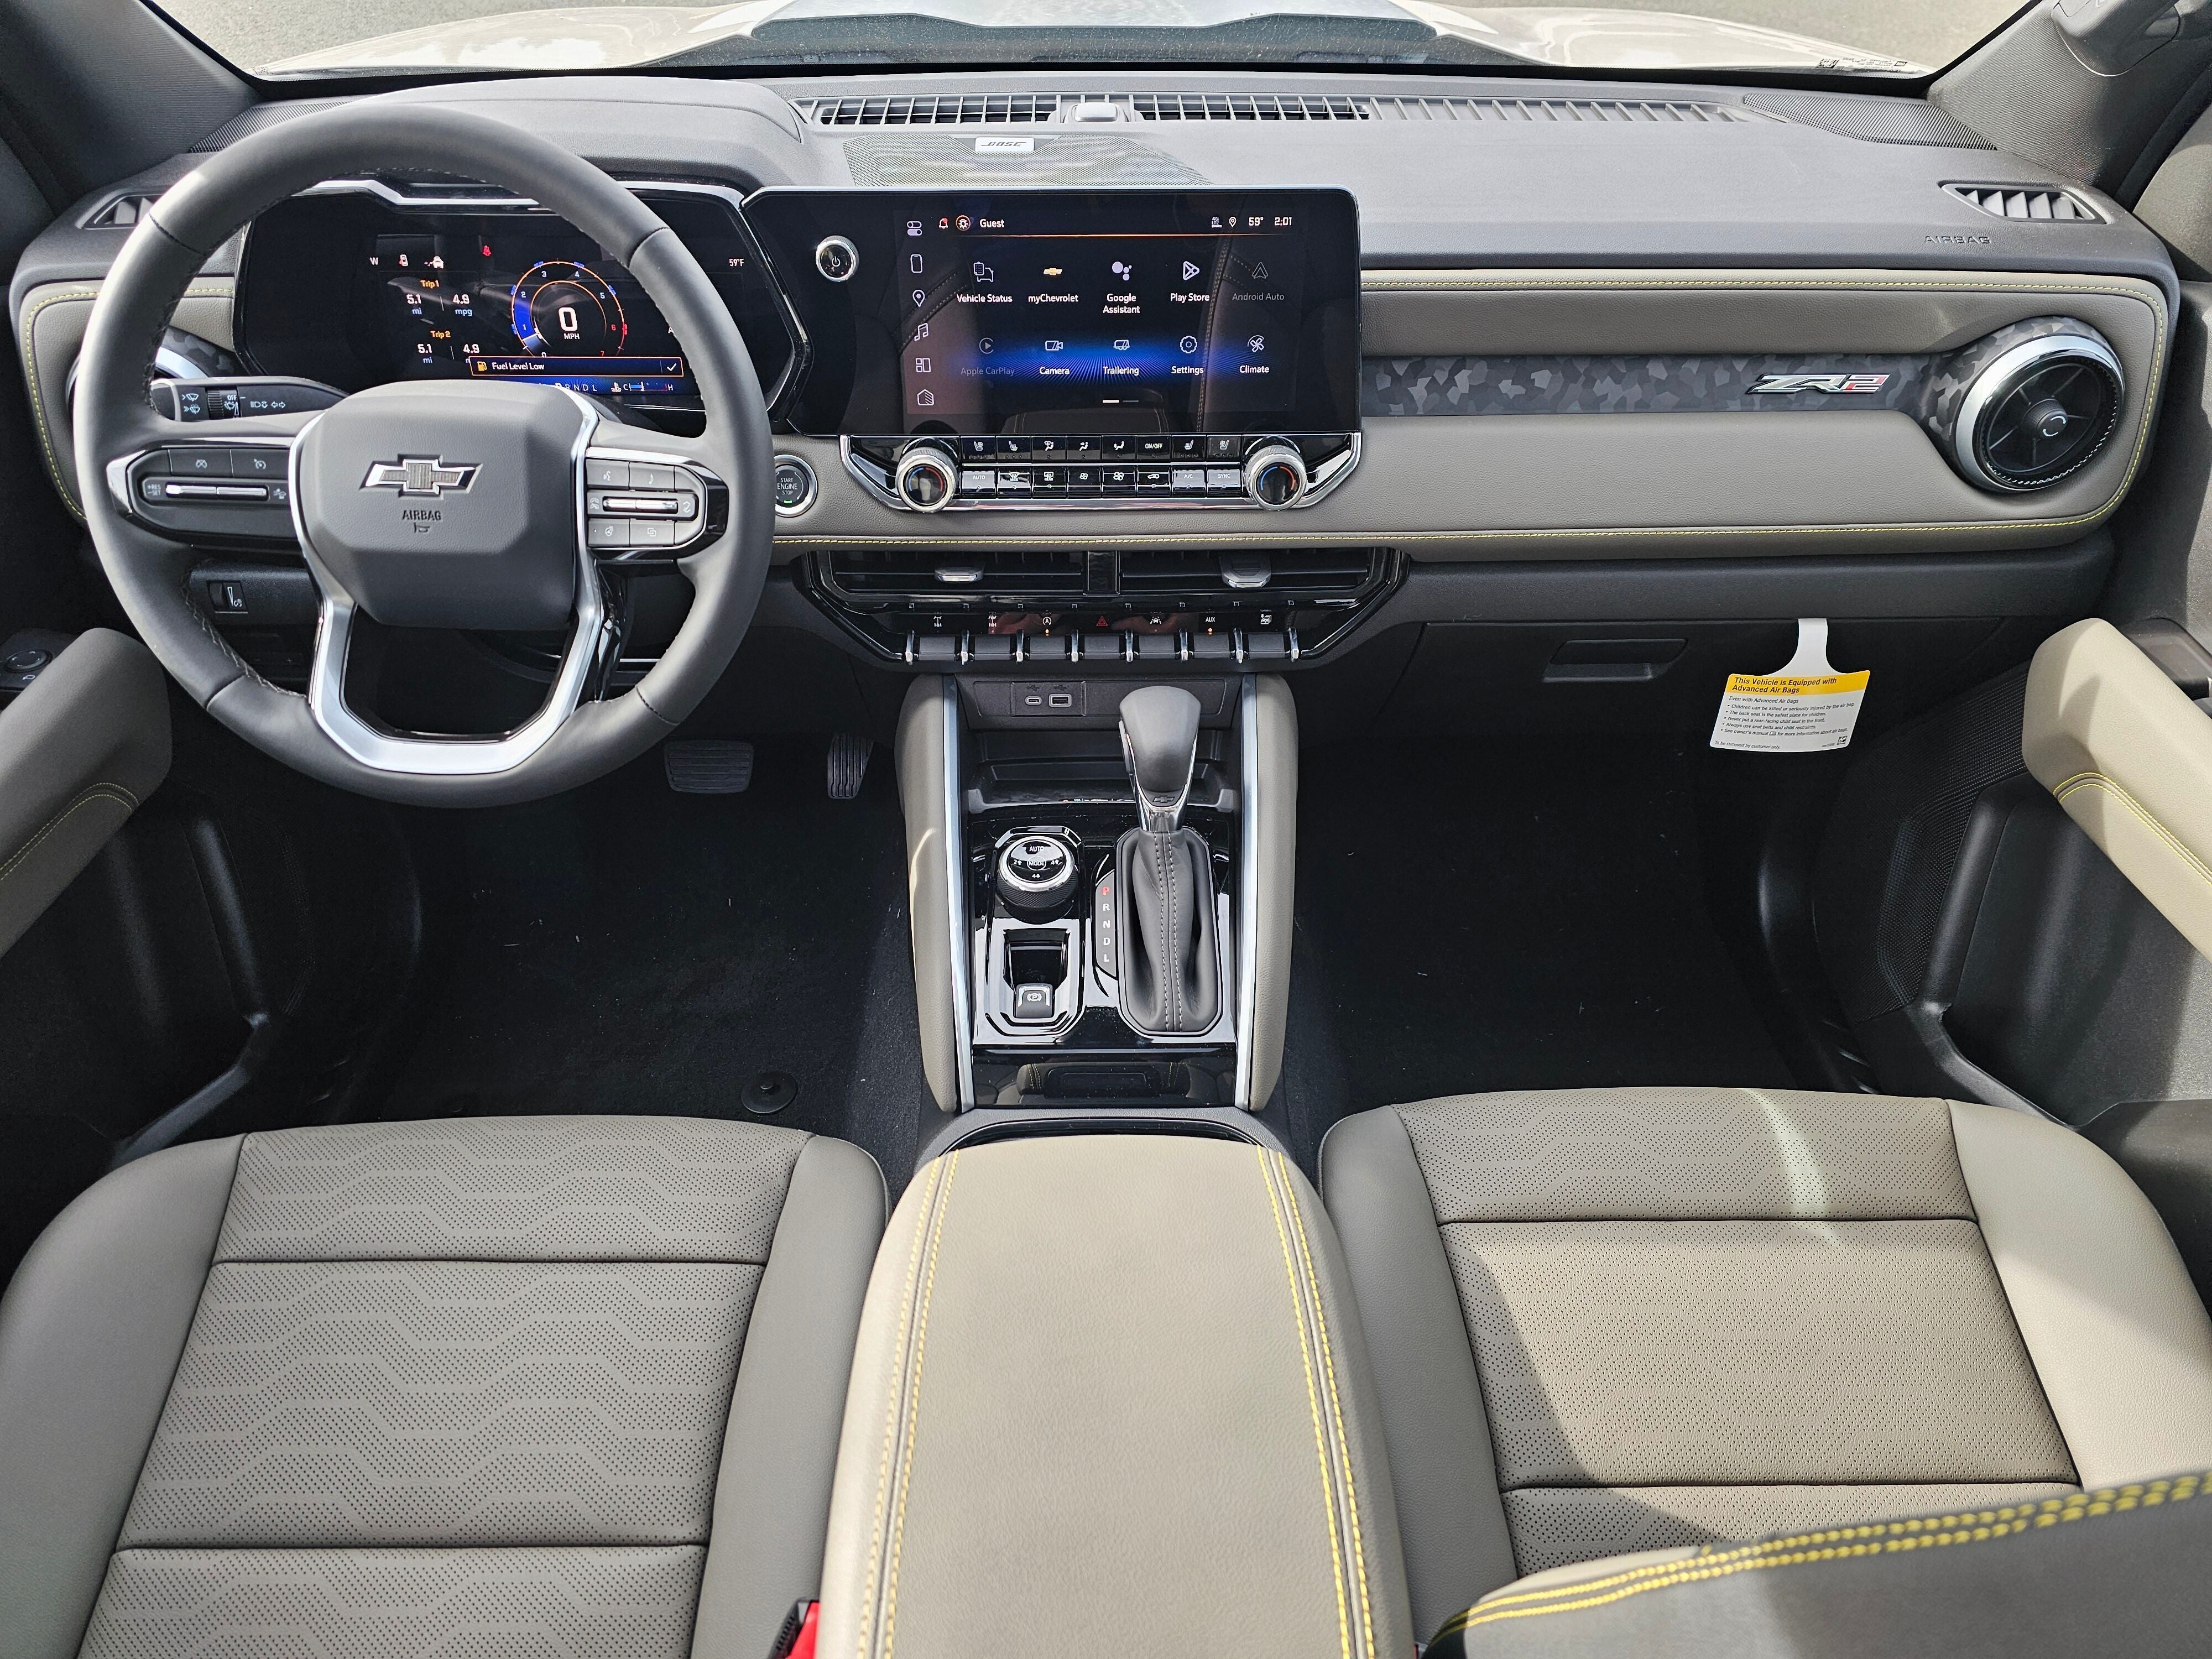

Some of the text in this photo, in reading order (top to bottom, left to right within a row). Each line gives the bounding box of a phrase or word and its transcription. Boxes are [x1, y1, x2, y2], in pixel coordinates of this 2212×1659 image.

[979, 219, 1005, 228] Guest
[1249, 217, 1292, 226] 59° 2:01
[369, 257, 378, 265] W
[420, 280, 435, 289] Trip
[406, 294, 421, 304] 5.1
[453, 294, 469, 304] 4.9
[957, 294, 1013, 302] Vehicle Status
[1029, 294, 1078, 304] myChevrolet
[1107, 293, 1136, 304] Google
[1170, 293, 1210, 302] Play Store
[1103, 305, 1140, 314] Assistant
[559, 307, 578, 331] 0
[418, 344, 432, 353] 5.1
[463, 344, 479, 353] 4.9
[961, 367, 1015, 376] Apple CarPlay
[1039, 367, 1070, 375] Camera
[1103, 366, 1139, 376] Trailering
[1171, 366, 1204, 375] Settings
[1745, 374, 1890, 394] ZR2
[401, 509, 442, 521] AIRBAG
[1102, 886, 1110, 896] P
[1103, 903, 1110, 911] R
[1103, 920, 1110, 928] N
[1103, 937, 1110, 946] D
[1104, 954, 1110, 962] L
